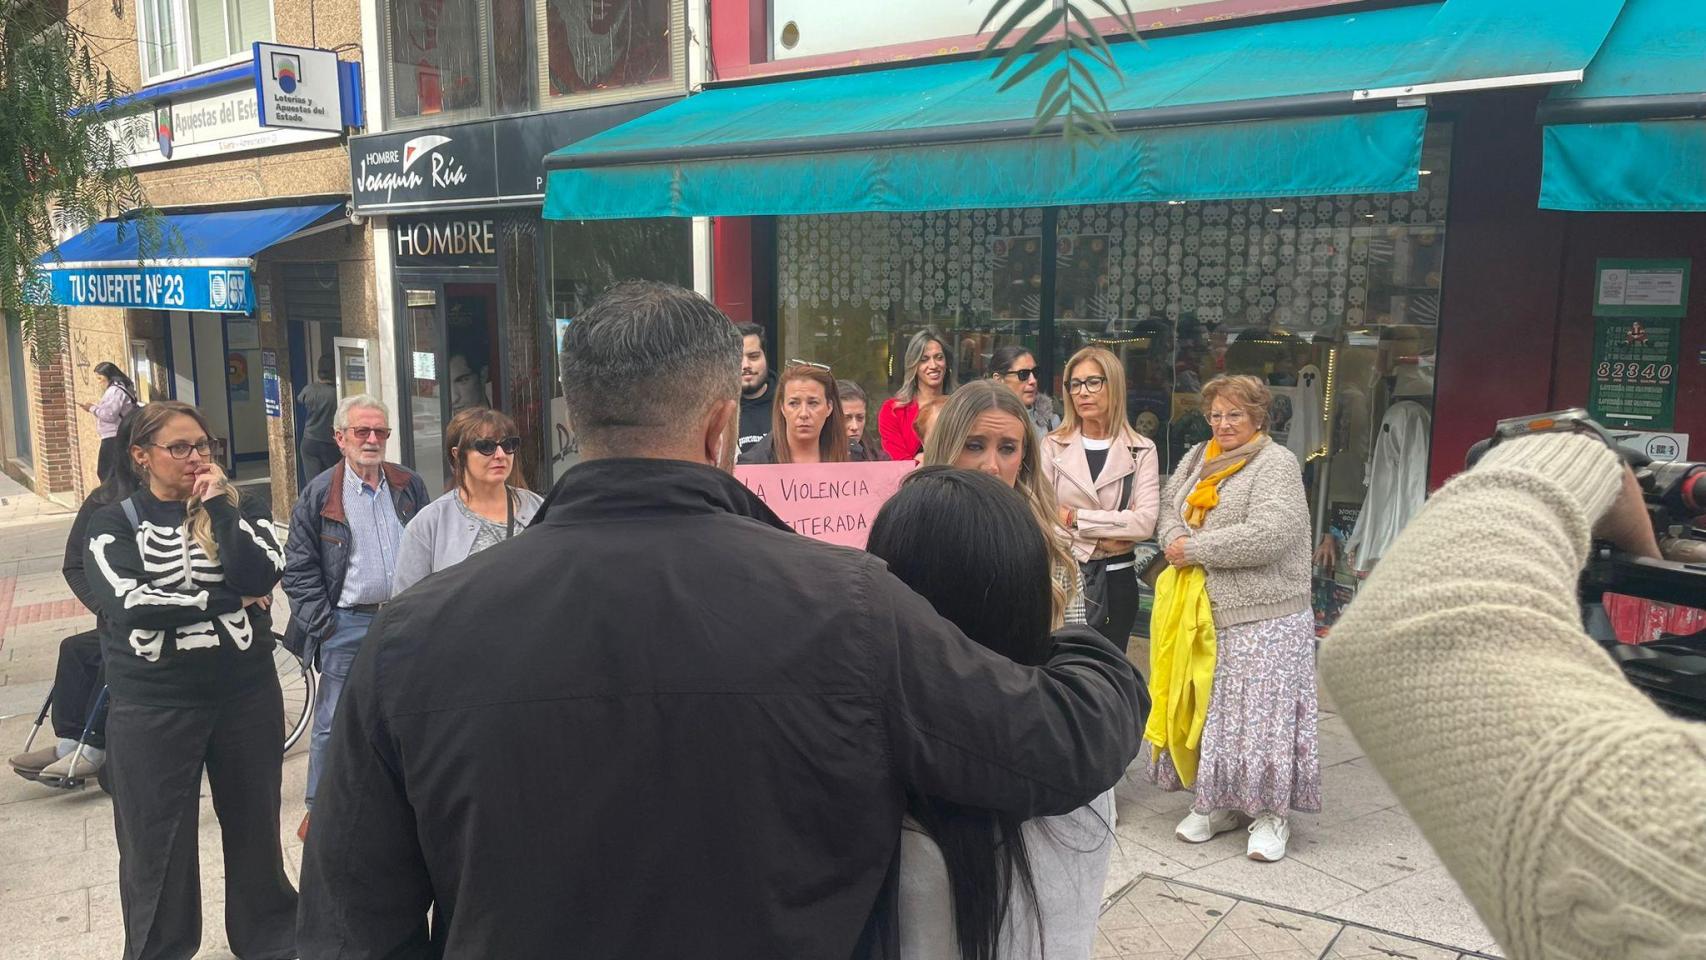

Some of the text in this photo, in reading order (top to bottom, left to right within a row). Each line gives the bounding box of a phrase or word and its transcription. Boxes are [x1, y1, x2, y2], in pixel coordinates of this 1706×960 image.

[276, 104, 325, 115] Apuestas del
[307, 98, 312, 106] y
[175, 107, 217, 136] Apuestas
[220, 100, 235, 124] del
[276, 112, 303, 121] Estado
[366, 150, 400, 166] HOMBRE
[431, 152, 467, 188] Rúa
[397, 220, 496, 256] HOMBRE
[69, 274, 86, 303] TU
[87, 273, 141, 304] SUERTE
[164, 274, 185, 306] 23
[780, 478, 869, 502] VIOLENCIA
[785, 513, 867, 536] ITERADA
